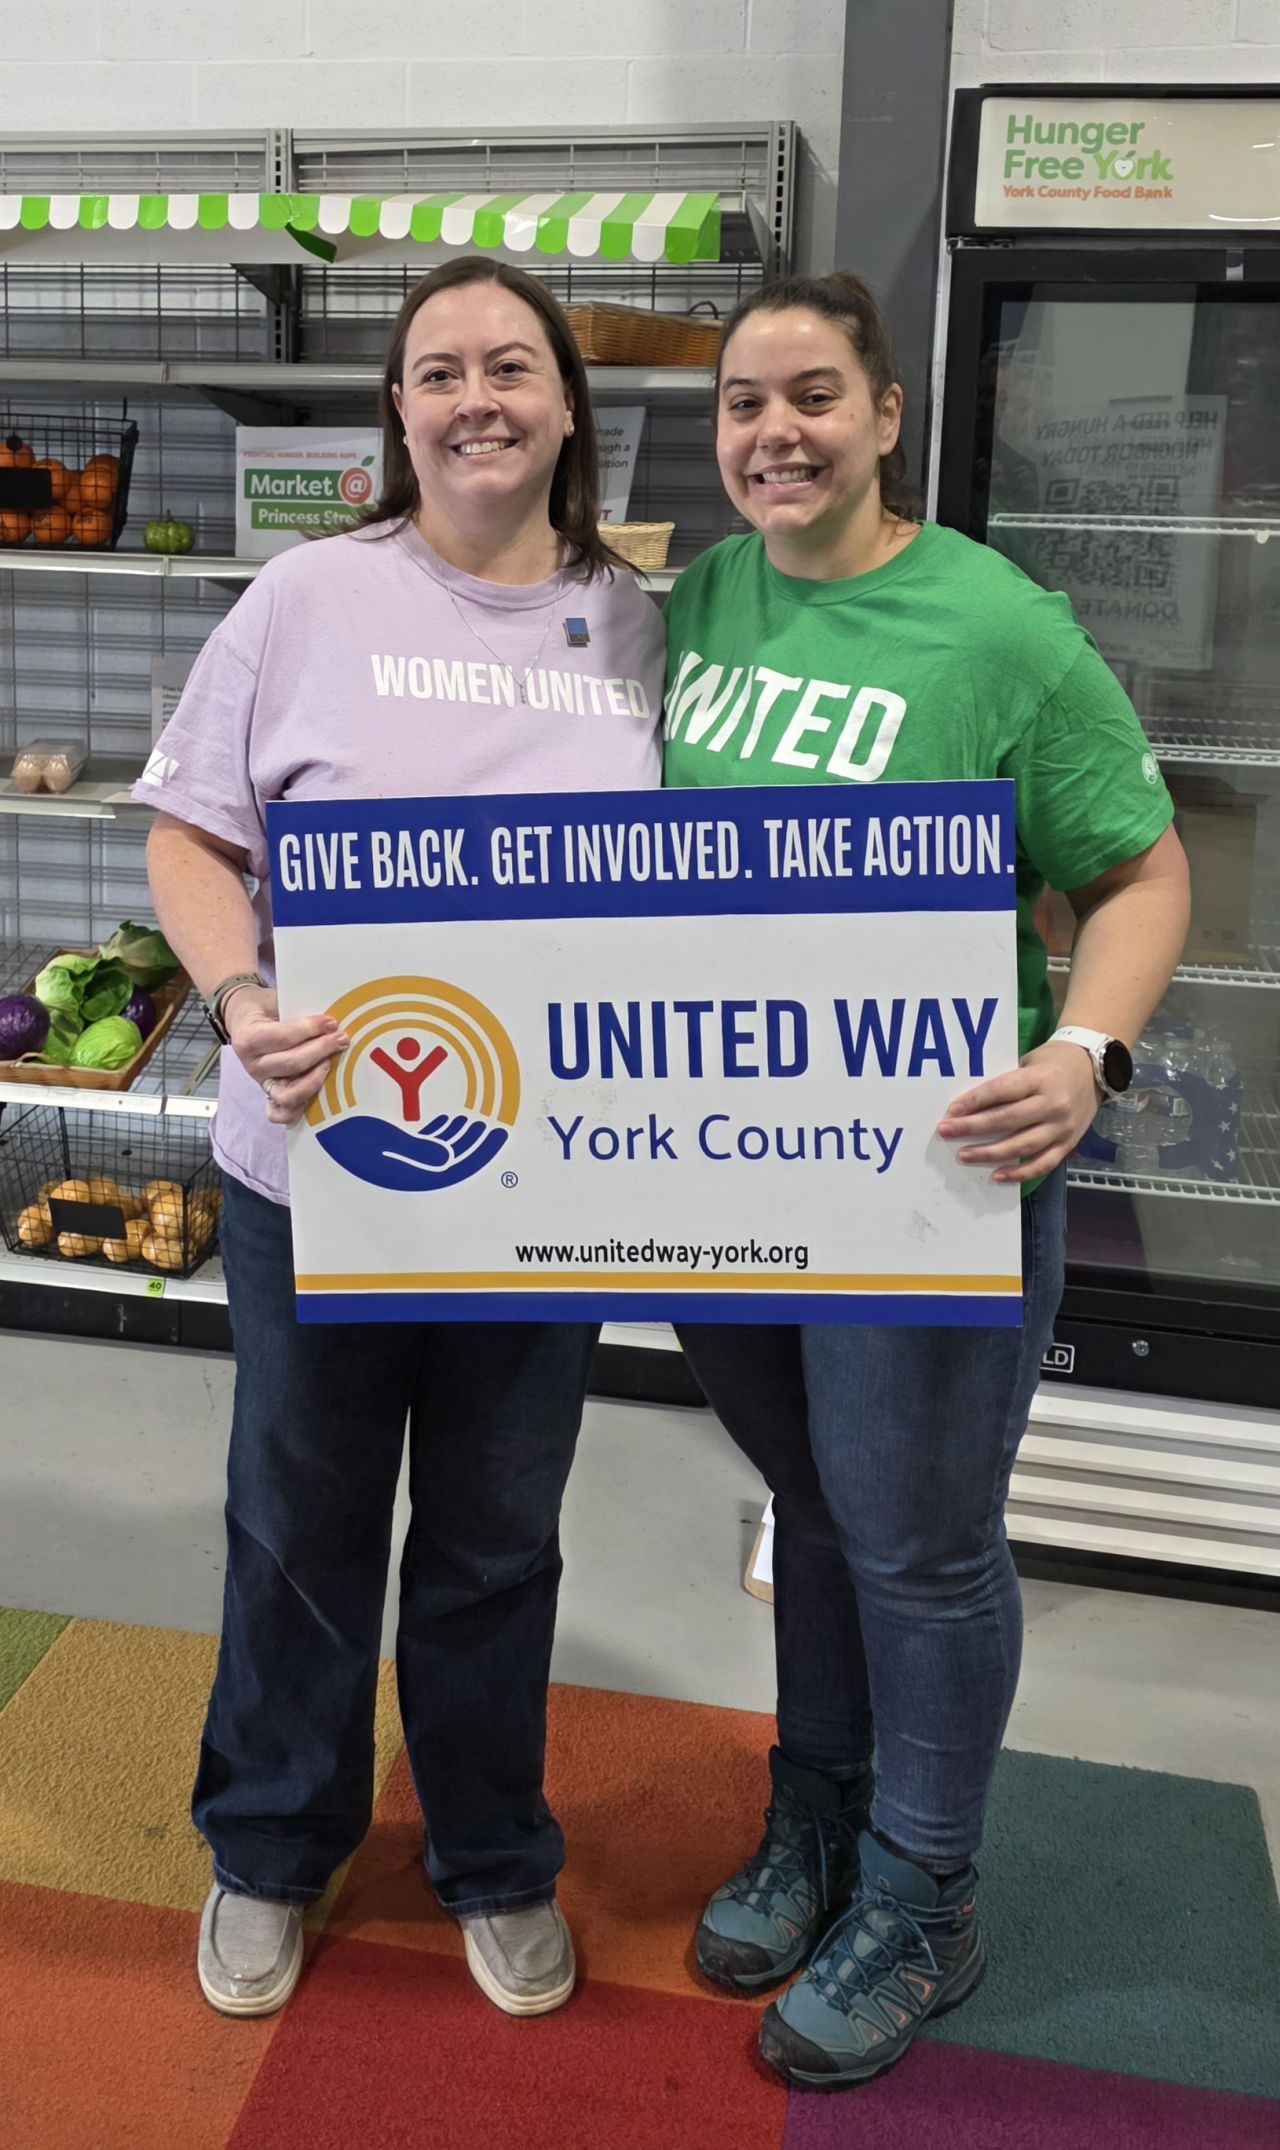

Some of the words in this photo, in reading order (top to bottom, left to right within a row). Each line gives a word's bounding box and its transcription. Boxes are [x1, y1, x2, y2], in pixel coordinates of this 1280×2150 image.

[1006, 114, 1146, 154] Hunger
[1003, 149, 1085, 180] Free
[1093, 149, 1174, 181] York
[1003, 185, 1035, 198] York
[1037, 185, 1091, 200] County
[1093, 186, 1131, 199] Food
[1134, 186, 1173, 199] Bank
[251, 474, 334, 497] Market
[346, 474, 367, 497] @
[258, 508, 320, 524] Princess
[371, 654, 516, 708] WOMEN
[524, 667, 650, 719] UNITED
[279, 832, 362, 892] GIVE
[370, 828, 479, 889] BACK.
[490, 825, 553, 885] GET
[563, 820, 753, 883] INVOLVED.
[763, 818, 853, 879] TAKE
[863, 814, 1015, 877] ACTION.
[547, 1000, 809, 1080] UNITED
[833, 998, 999, 1077] WAY
[547, 1114, 679, 1161] York
[698, 1114, 904, 1174] County
[515, 1238, 809, 1269] www.unitedway-york.org
[148, 1281, 162, 1290] 40
[1042, 1350, 1069, 1365] LD
